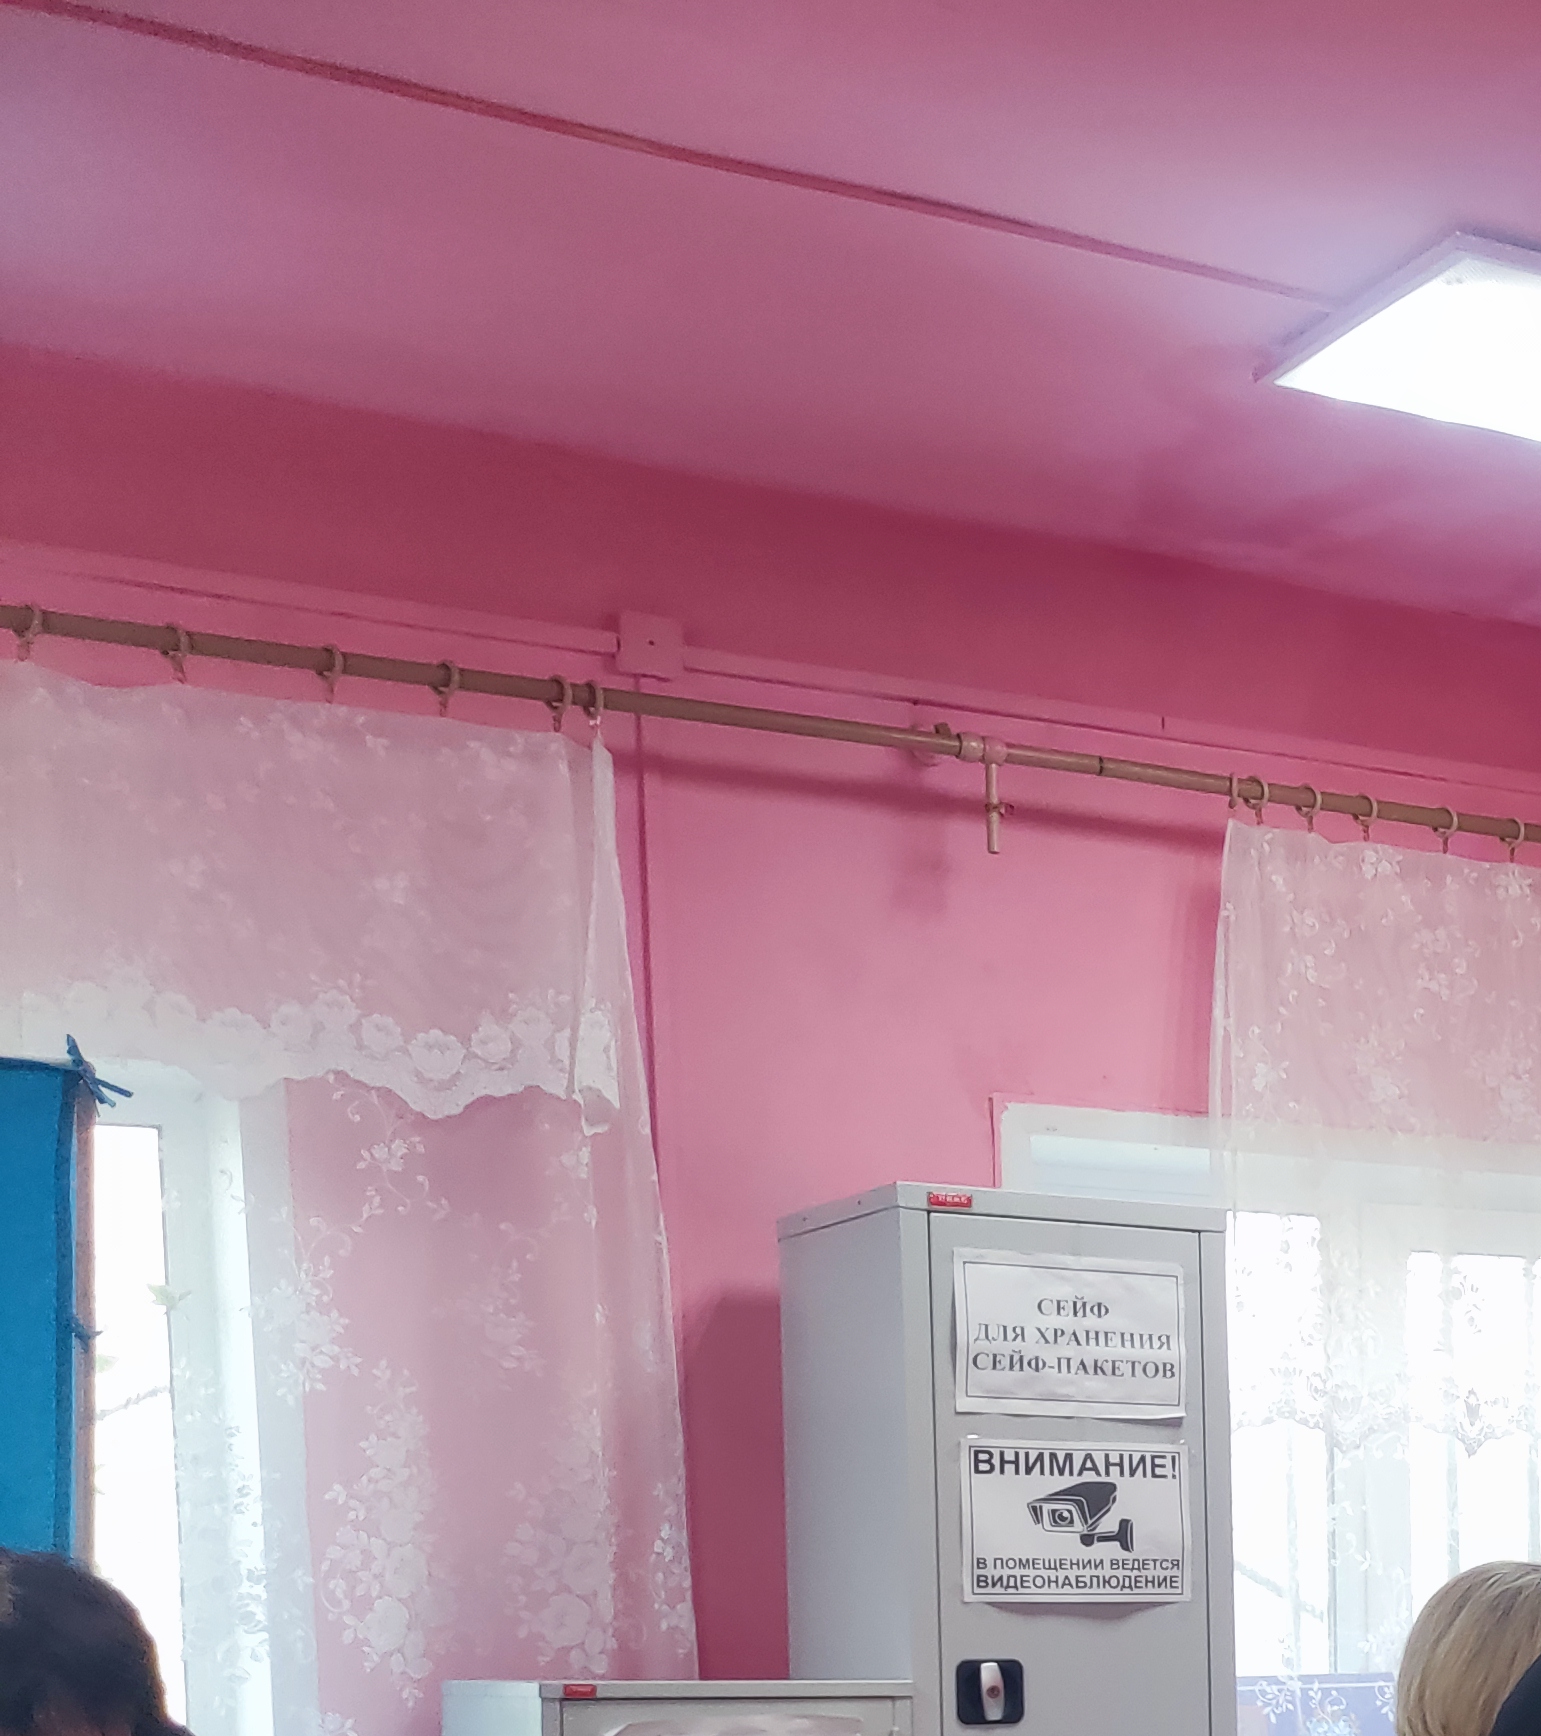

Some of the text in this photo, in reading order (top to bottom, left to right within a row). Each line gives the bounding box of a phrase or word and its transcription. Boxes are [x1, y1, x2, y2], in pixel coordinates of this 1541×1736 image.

[1036, 1295, 1110, 1319] СЕЙФ
[973, 1322, 1172, 1351] ДЛЯ ХРАНЕНИЯ
[971, 1349, 1177, 1380] СЕЙФ-ПАКЕТОВ
[973, 1449, 1178, 1480] ВНИМАНИЕ!
[976, 1557, 1181, 1573] В ПОМЕЩЕНИИ ВЕДЕТСЯ
[975, 1574, 1180, 1592] ВИДЕОНАБЛЮДЕНИЕ
